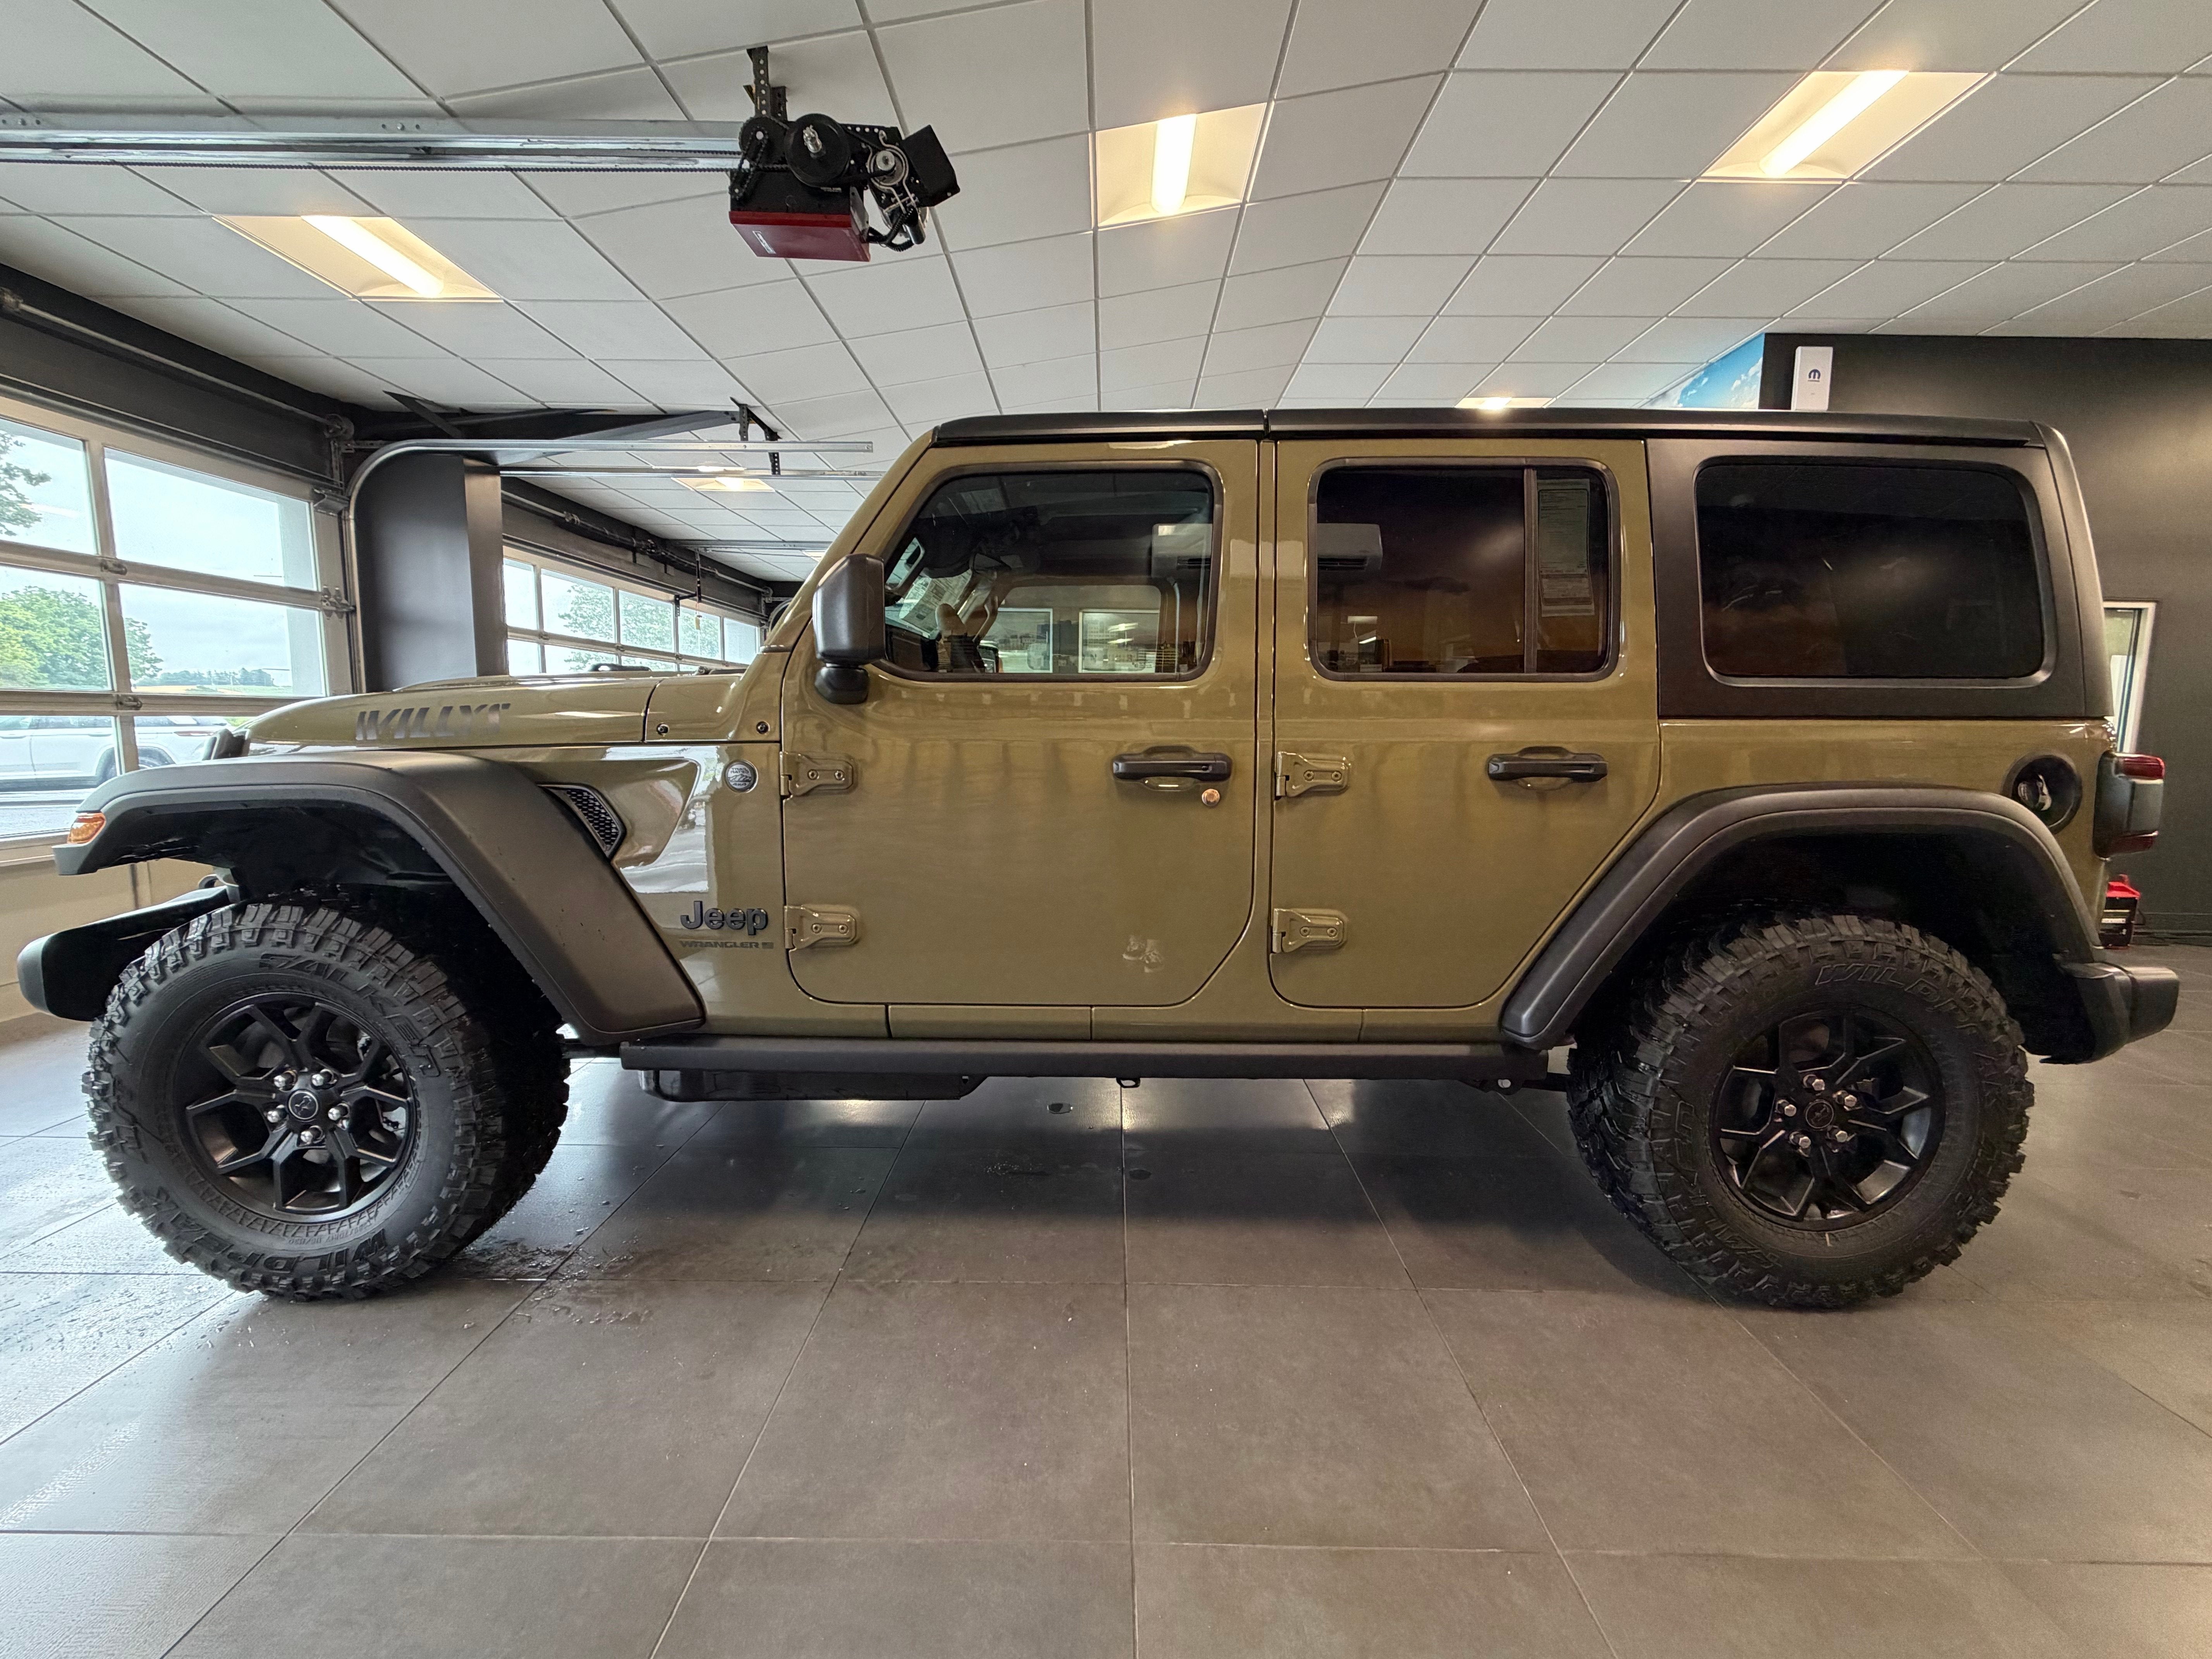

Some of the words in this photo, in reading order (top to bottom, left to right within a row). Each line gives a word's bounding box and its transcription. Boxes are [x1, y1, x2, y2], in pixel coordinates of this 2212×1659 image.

[680, 901, 768, 936] Jeep
[680, 941, 760, 949] WRANGLER
[259, 953, 441, 1077] FALKEN
